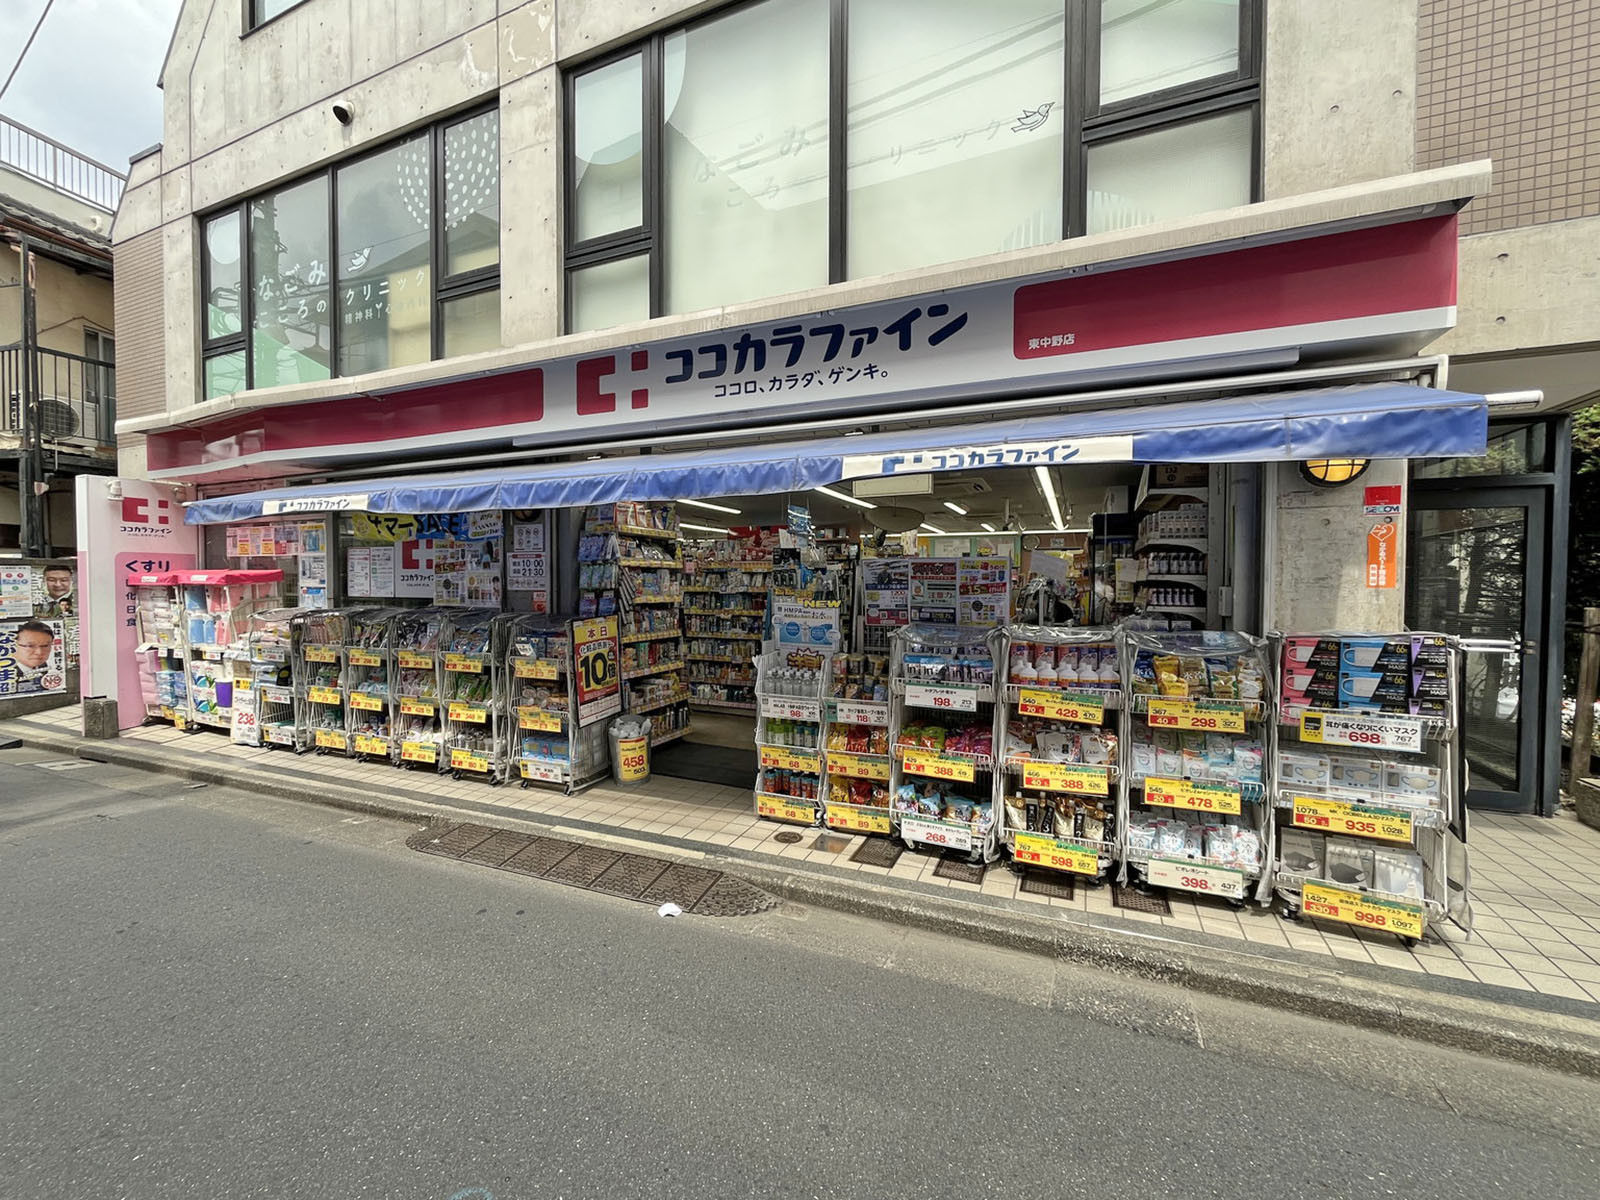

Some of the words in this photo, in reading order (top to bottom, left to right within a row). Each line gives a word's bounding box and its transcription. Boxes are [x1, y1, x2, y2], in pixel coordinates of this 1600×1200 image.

[259, 260, 326, 300] なごみ
[346, 269, 424, 305] クリニック
[665, 303, 968, 384] ココカラファイン
[1028, 333, 1075, 350] 東中野店
[715, 362, 888, 398] ココロ、カラダ、ゲンキ。
[932, 444, 1080, 471] ココカラファイン
[120, 526, 173, 534] ココカラファイン
[367, 514, 414, 536] サマー
[125, 560, 170, 572] くすり
[522, 559, 544, 567] 10:00
[522, 568, 544, 576] 21:30
[803, 600, 841, 608] NEW
[587, 626, 608, 638] 本日
[580, 652, 608, 689] 10
[907, 664, 916, 673] in
[923, 665, 933, 675] in
[952, 667, 961, 678] in
[974, 668, 985, 679] in
[933, 697, 951, 707] 198
[790, 710, 801, 718] 98
[856, 714, 868, 723] 118
[1055, 708, 1079, 718] 428
[237, 712, 255, 726] 238
[1191, 717, 1216, 728] 298
[1326, 720, 1418, 735] 耳が痛くなりにくいマスク
[1348, 731, 1381, 744] 698
[623, 754, 645, 768] 458
[789, 760, 800, 768] 68
[857, 767, 869, 776] 89
[934, 766, 953, 776] 388
[1060, 779, 1084, 790] 388
[1154, 795, 1165, 803] 20
[1187, 796, 1213, 808] 478
[785, 810, 796, 818] 68
[858, 820, 869, 828] 89
[1345, 820, 1376, 833] 935
[925, 832, 946, 844] 268
[1019, 843, 1031, 851] 767
[1051, 855, 1073, 868] 598
[1180, 876, 1209, 890] 398
[1309, 904, 1330, 914] 330
[1354, 910, 1386, 926] 998
